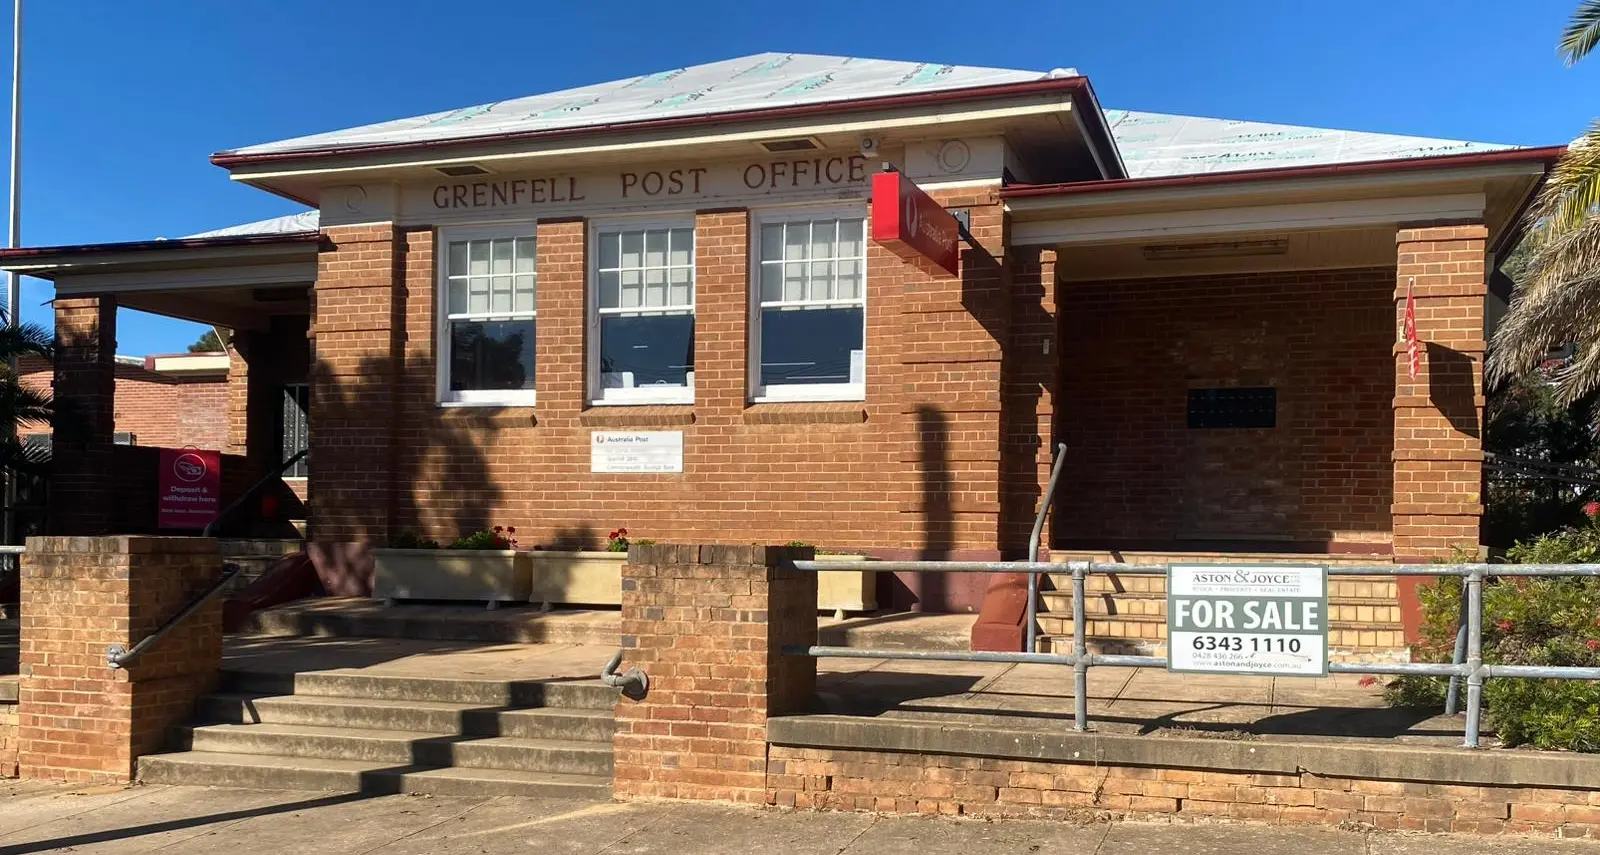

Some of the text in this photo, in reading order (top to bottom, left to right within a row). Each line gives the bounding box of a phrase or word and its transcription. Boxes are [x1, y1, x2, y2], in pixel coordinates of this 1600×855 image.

[433, 155, 867, 209] GRENFELL POST OFFICE
[170, 486, 200, 494] Deposit
[1192, 574, 1231, 583] ASTON
[1234, 569, 1250, 583] &
[1251, 574, 1290, 584] JOYCE
[1175, 600, 1318, 631] FOR SALE
[1192, 636, 1301, 653] 6343 1110
[1192, 660, 1302, 669] www.astonandjoyce.com.au
